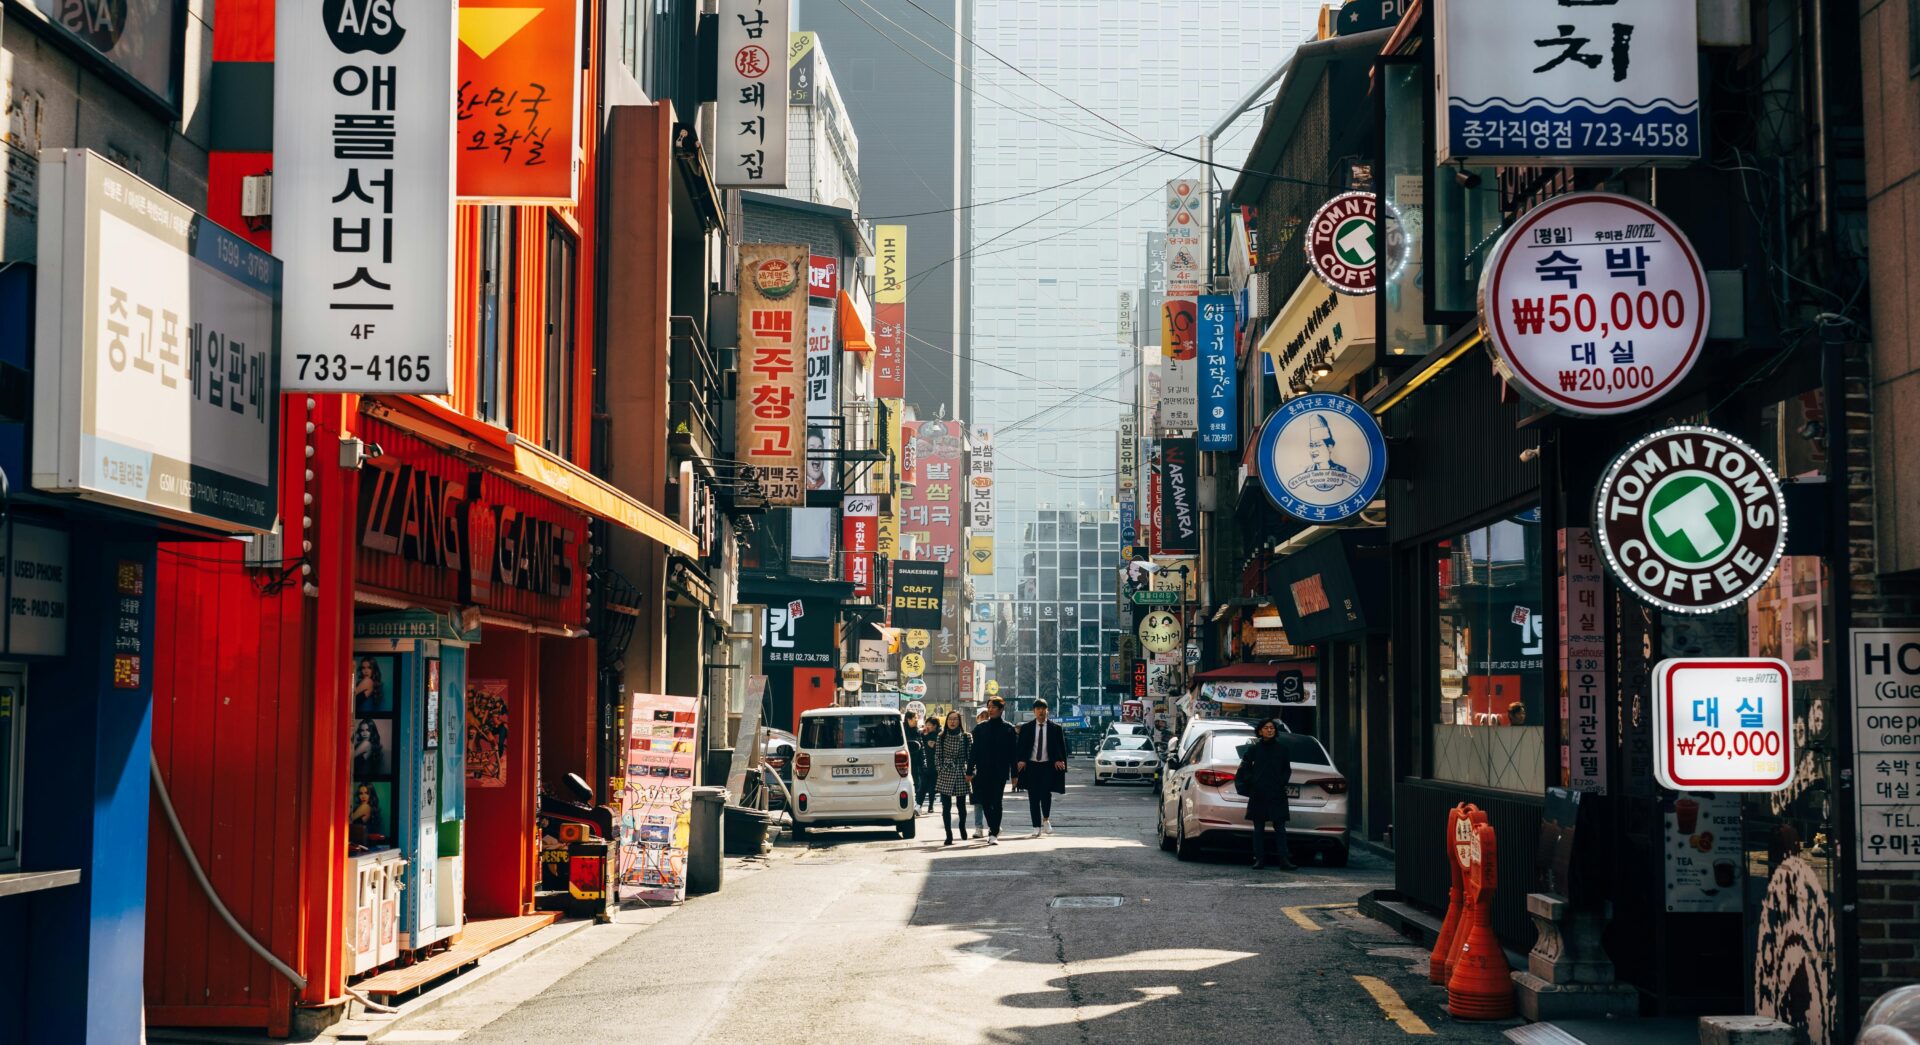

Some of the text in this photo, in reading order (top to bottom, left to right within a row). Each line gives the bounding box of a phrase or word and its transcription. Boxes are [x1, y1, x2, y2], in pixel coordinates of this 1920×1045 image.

[338, 0, 392, 34] A/S
[737, 0, 769, 180] 남 돼지집
[1462, 120, 1688, 149] 종각직영점 723-4558
[331, 65, 397, 291] 애플서비스
[1316, 206, 1345, 245] TOM
[1345, 200, 1359, 214] N
[1595, 230, 1623, 242] 우미관
[1625, 224, 1656, 239] HOTEL
[884, 238, 896, 291] HIKARI
[1512, 290, 1684, 339] ₩50,000
[350, 325, 375, 340] 4F
[296, 353, 431, 382] 733-4165
[1559, 366, 1654, 394] ₩20,000
[751, 310, 794, 457] 맥주창고
[1166, 447, 1193, 538] WARAWARA
[1611, 439, 1775, 529] TOM N TOMS
[500, 504, 575, 598] GAMES
[14, 560, 34, 579] USED
[36, 563, 63, 583] PHONE
[1620, 539, 1764, 601] COFFEE
[895, 596, 939, 609] BEER
[369, 623, 435, 636] BOOTH NO.1
[1141, 630, 1180, 644] 국자비어
[1570, 646, 1604, 658] Guesthouse
[1578, 674, 1598, 777] 우미관호텔
[1867, 716, 1903, 729] one
[1677, 731, 1780, 760] ₩20,000
[1876, 760, 1909, 776] 숙박
[1877, 782, 1909, 799] 대실
